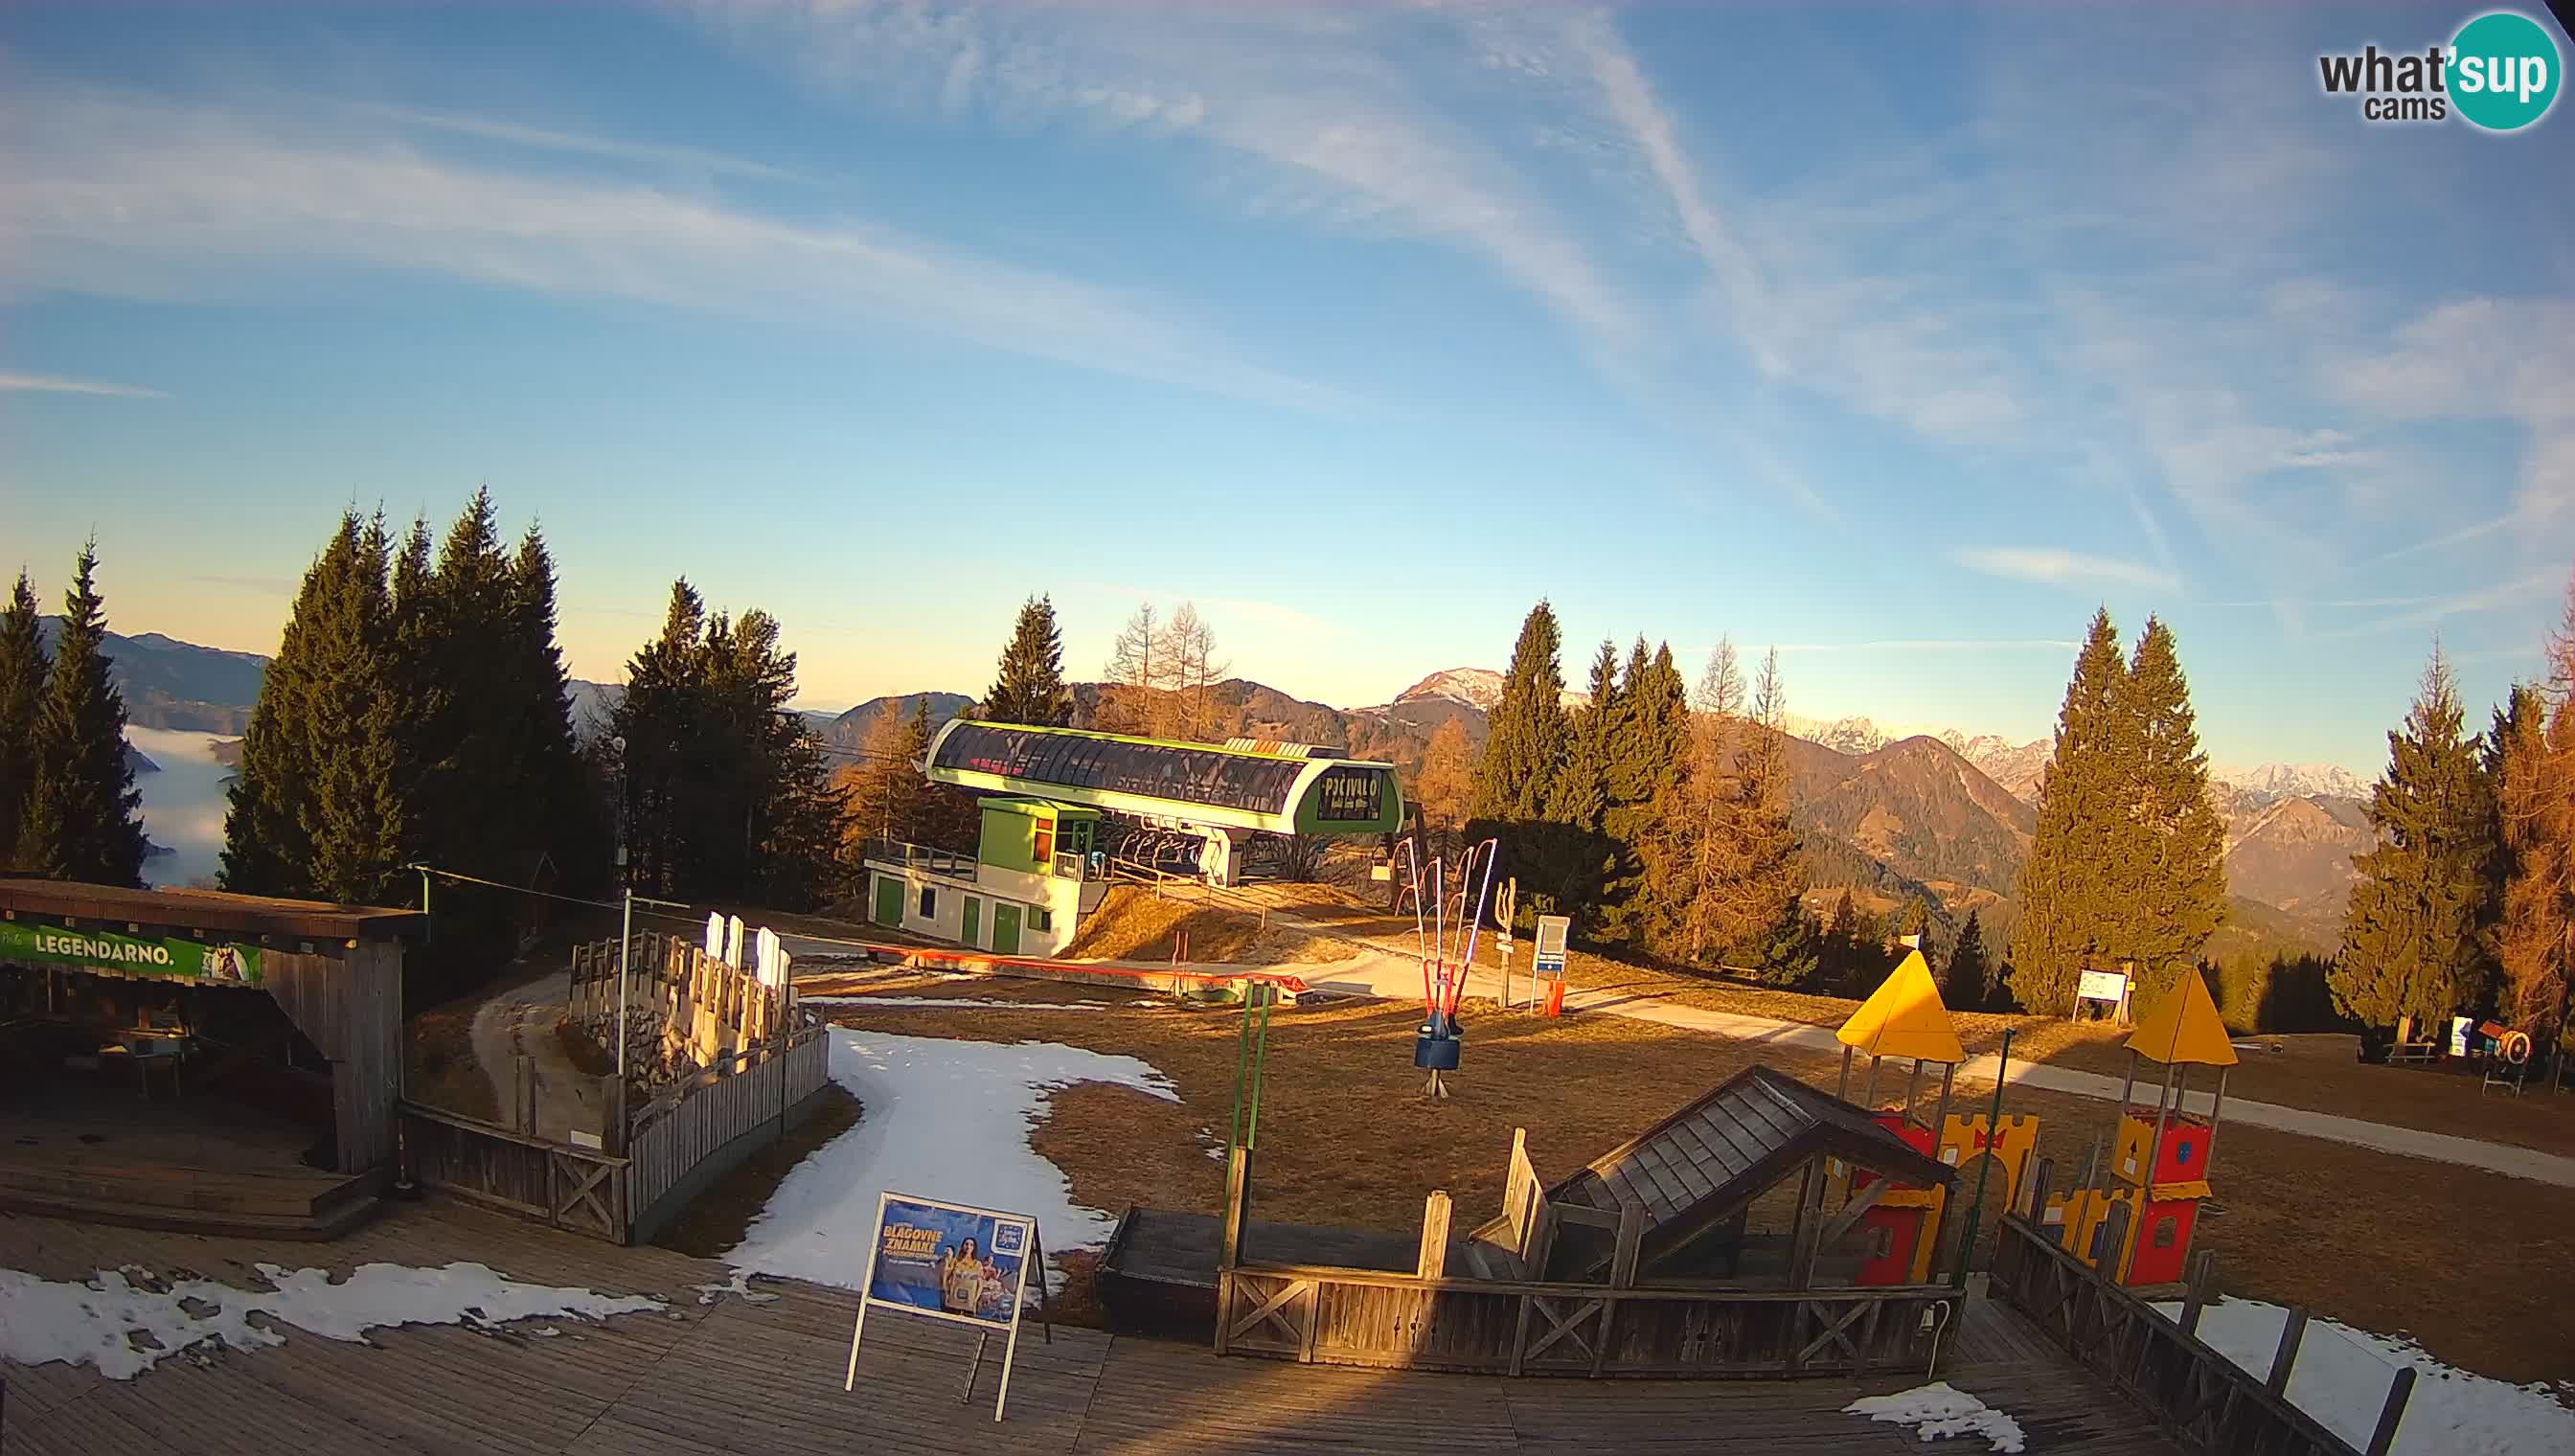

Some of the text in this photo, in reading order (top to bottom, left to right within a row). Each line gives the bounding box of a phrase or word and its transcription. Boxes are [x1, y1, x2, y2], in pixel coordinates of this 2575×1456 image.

[35, 934, 174, 967] LEGENDARNO.
[883, 1225, 944, 1242] BLAGOVNE
[884, 1238, 936, 1254] ZNAMKE
